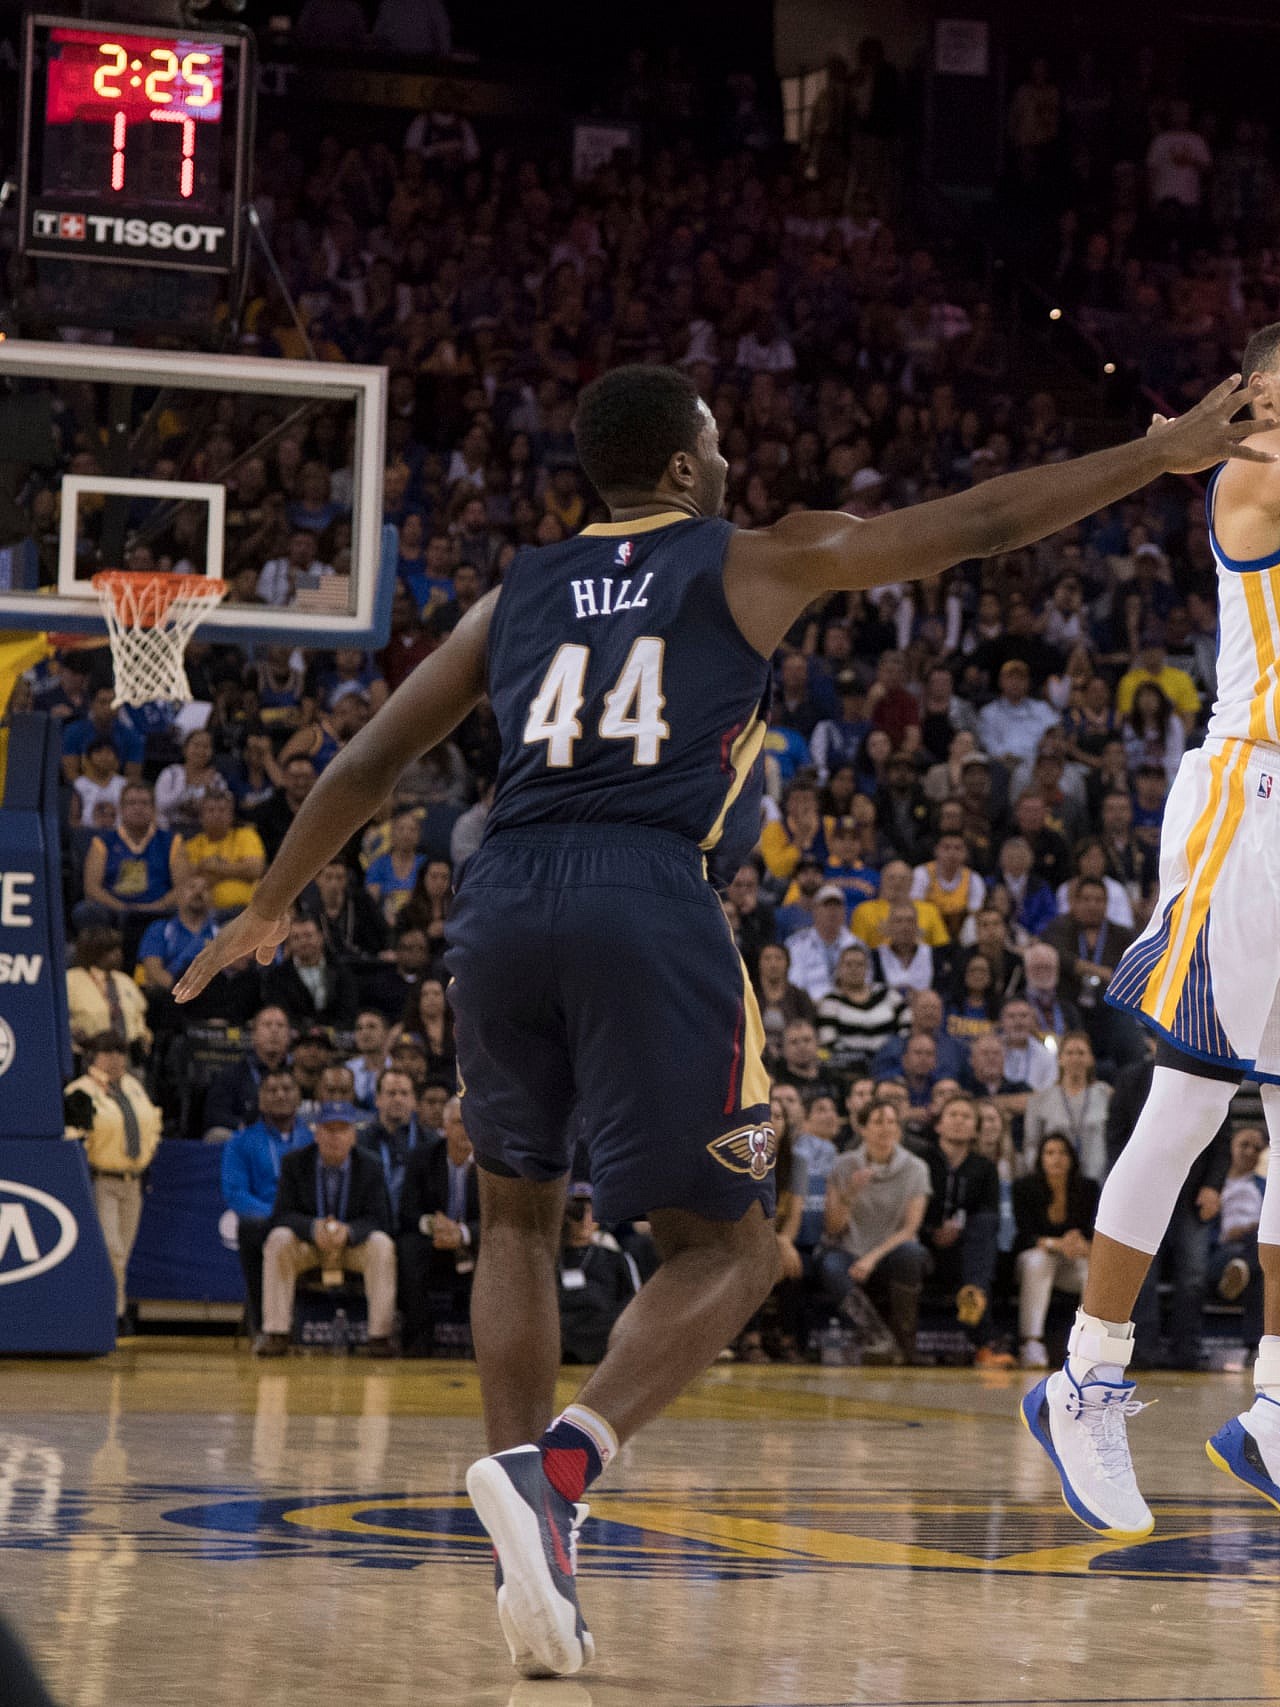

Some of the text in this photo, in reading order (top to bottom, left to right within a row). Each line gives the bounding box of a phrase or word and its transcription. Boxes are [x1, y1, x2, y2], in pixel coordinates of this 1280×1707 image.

[94, 43, 214, 107] 2:25
[111, 109, 196, 198] 17
[88, 215, 226, 253] TISSOT
[571, 573, 654, 618] HILL
[523, 636, 670, 767] 44
[0, 872, 36, 927] E
[0, 952, 44, 985] SN
